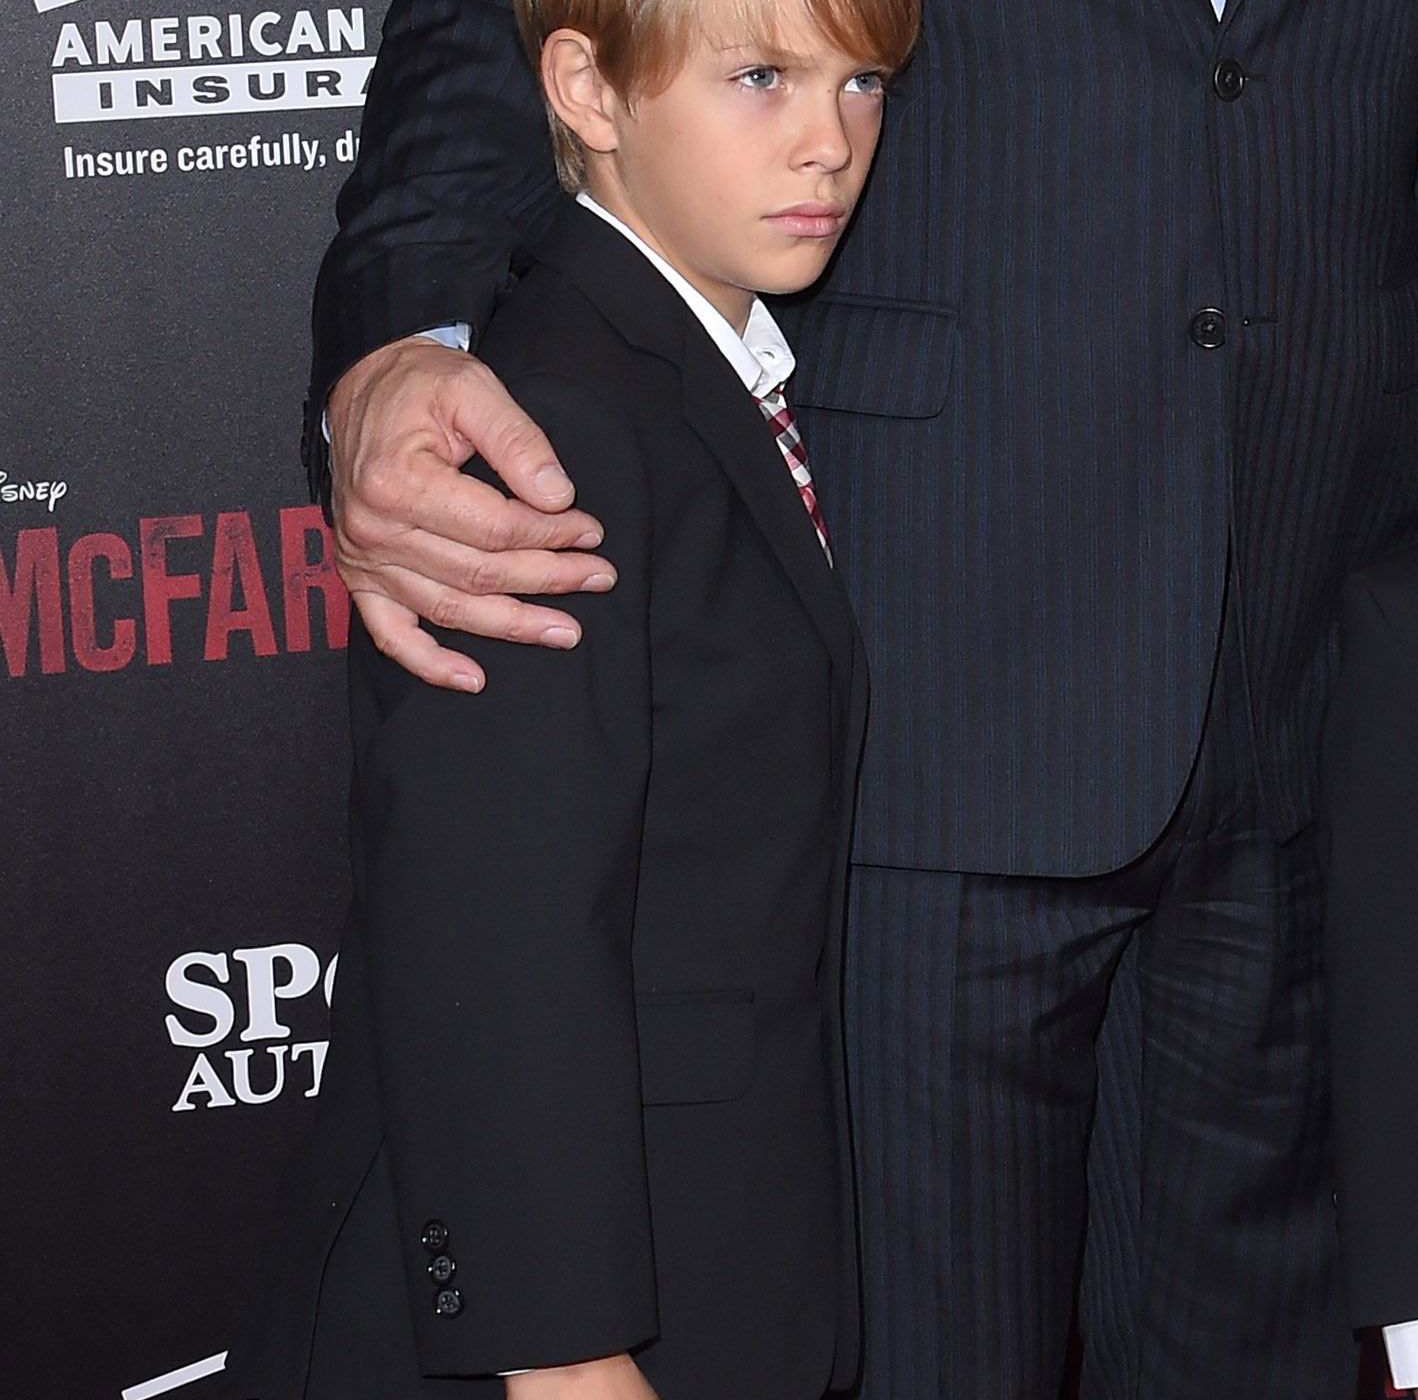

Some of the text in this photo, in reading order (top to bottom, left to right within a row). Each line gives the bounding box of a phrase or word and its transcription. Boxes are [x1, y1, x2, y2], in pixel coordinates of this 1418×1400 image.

[52, 8, 367, 67] AMERICAN
[64, 145, 168, 178] Insure
[177, 132, 327, 171] carefully,
